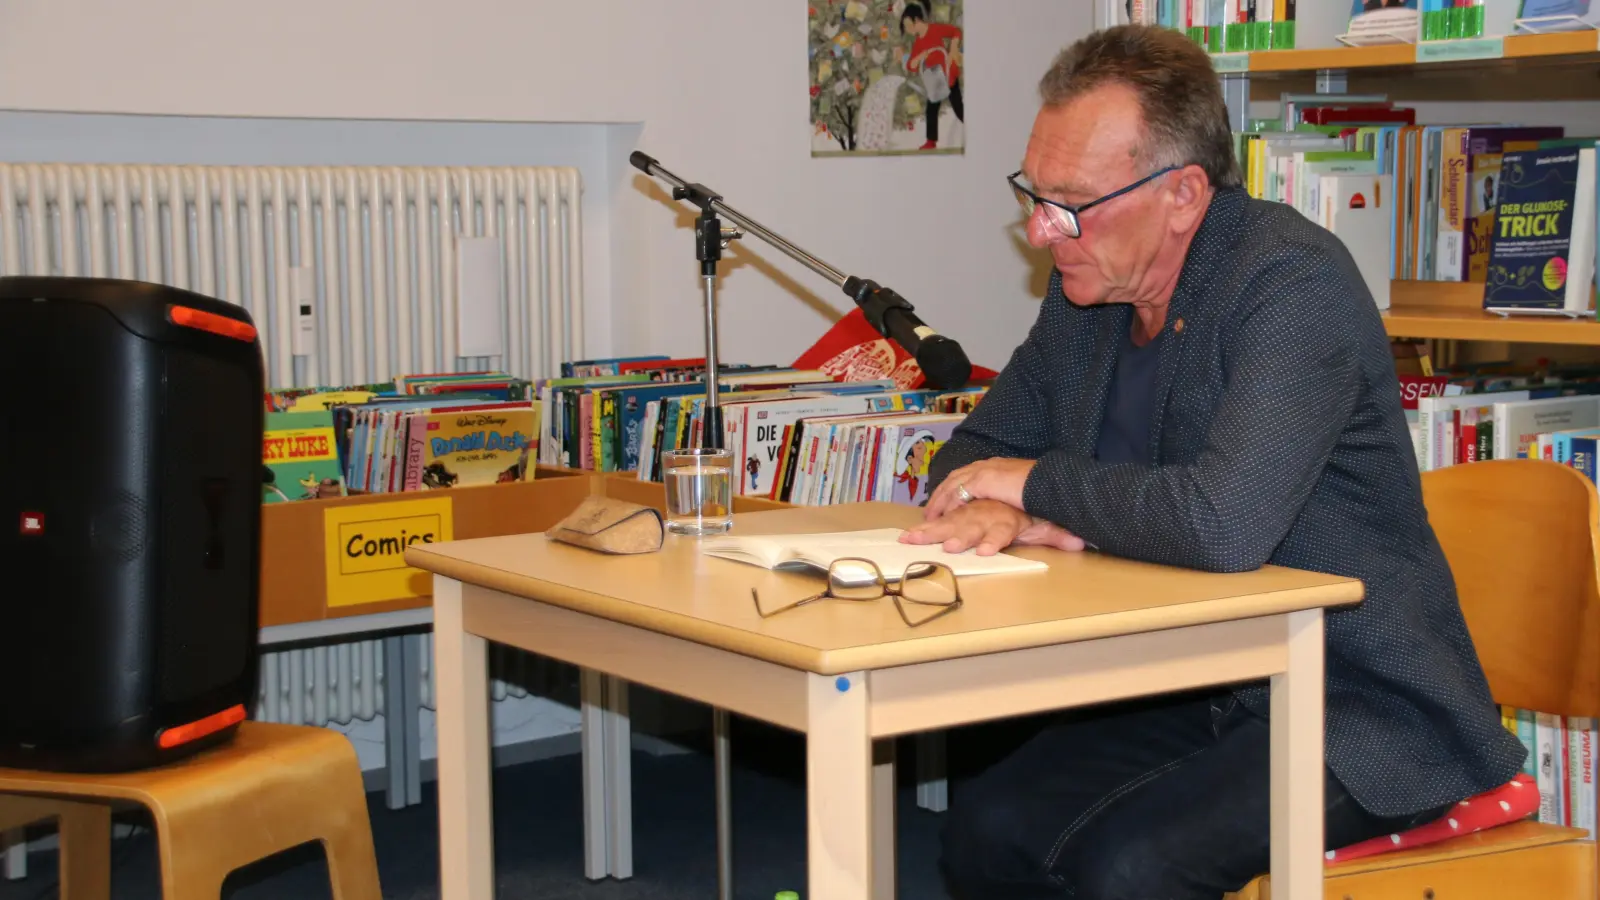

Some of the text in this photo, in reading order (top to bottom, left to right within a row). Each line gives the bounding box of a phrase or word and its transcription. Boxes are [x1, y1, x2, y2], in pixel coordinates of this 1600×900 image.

[1448, 158, 1464, 226] Schlagerstars
[1500, 199, 1568, 215] DER GLUKOSE-
[1498, 213, 1560, 238] TRICK
[476, 415, 507, 427] Disney
[756, 425, 777, 442] DIE
[287, 435, 329, 457] LUKE
[430, 430, 528, 457] Donald Duck
[346, 529, 434, 558] Comics
[1582, 728, 1592, 784] RHEUMA
